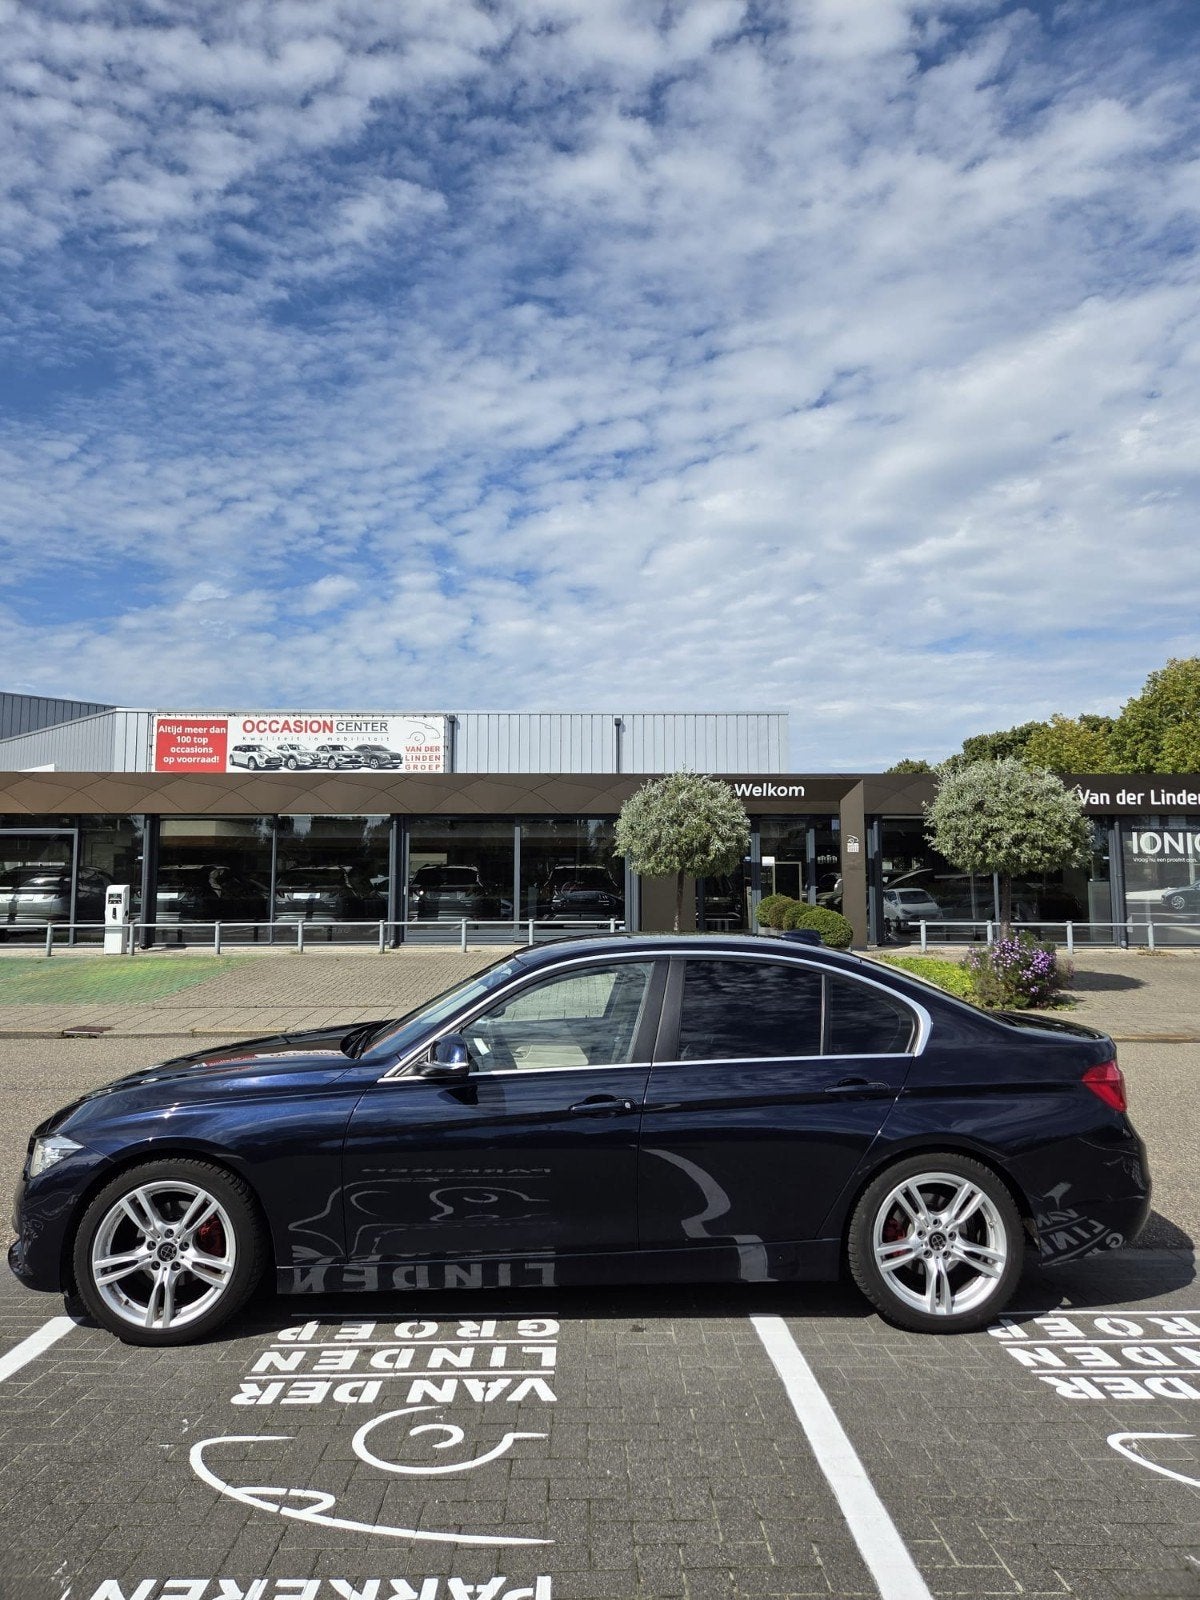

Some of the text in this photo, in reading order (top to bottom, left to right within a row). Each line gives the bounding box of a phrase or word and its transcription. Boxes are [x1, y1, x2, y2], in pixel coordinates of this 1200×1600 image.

[158, 725, 183, 735] Altijd
[209, 726, 227, 734] dan
[242, 720, 389, 734] OCCASION CENTER
[176, 735, 209, 745] 100 top
[163, 755, 220, 765] op voorraad!
[404, 754, 441, 762] LINDEN
[404, 763, 441, 771] GROEP
[734, 782, 806, 797] Welkom
[1078, 789, 1111, 806] Van
[1116, 789, 1145, 805] der
[277, 1318, 560, 1341] GROEP
[251, 1346, 558, 1373] LINDEN
[230, 1378, 558, 1405] VAN DER
[1038, 1375, 1200, 1400] DER
